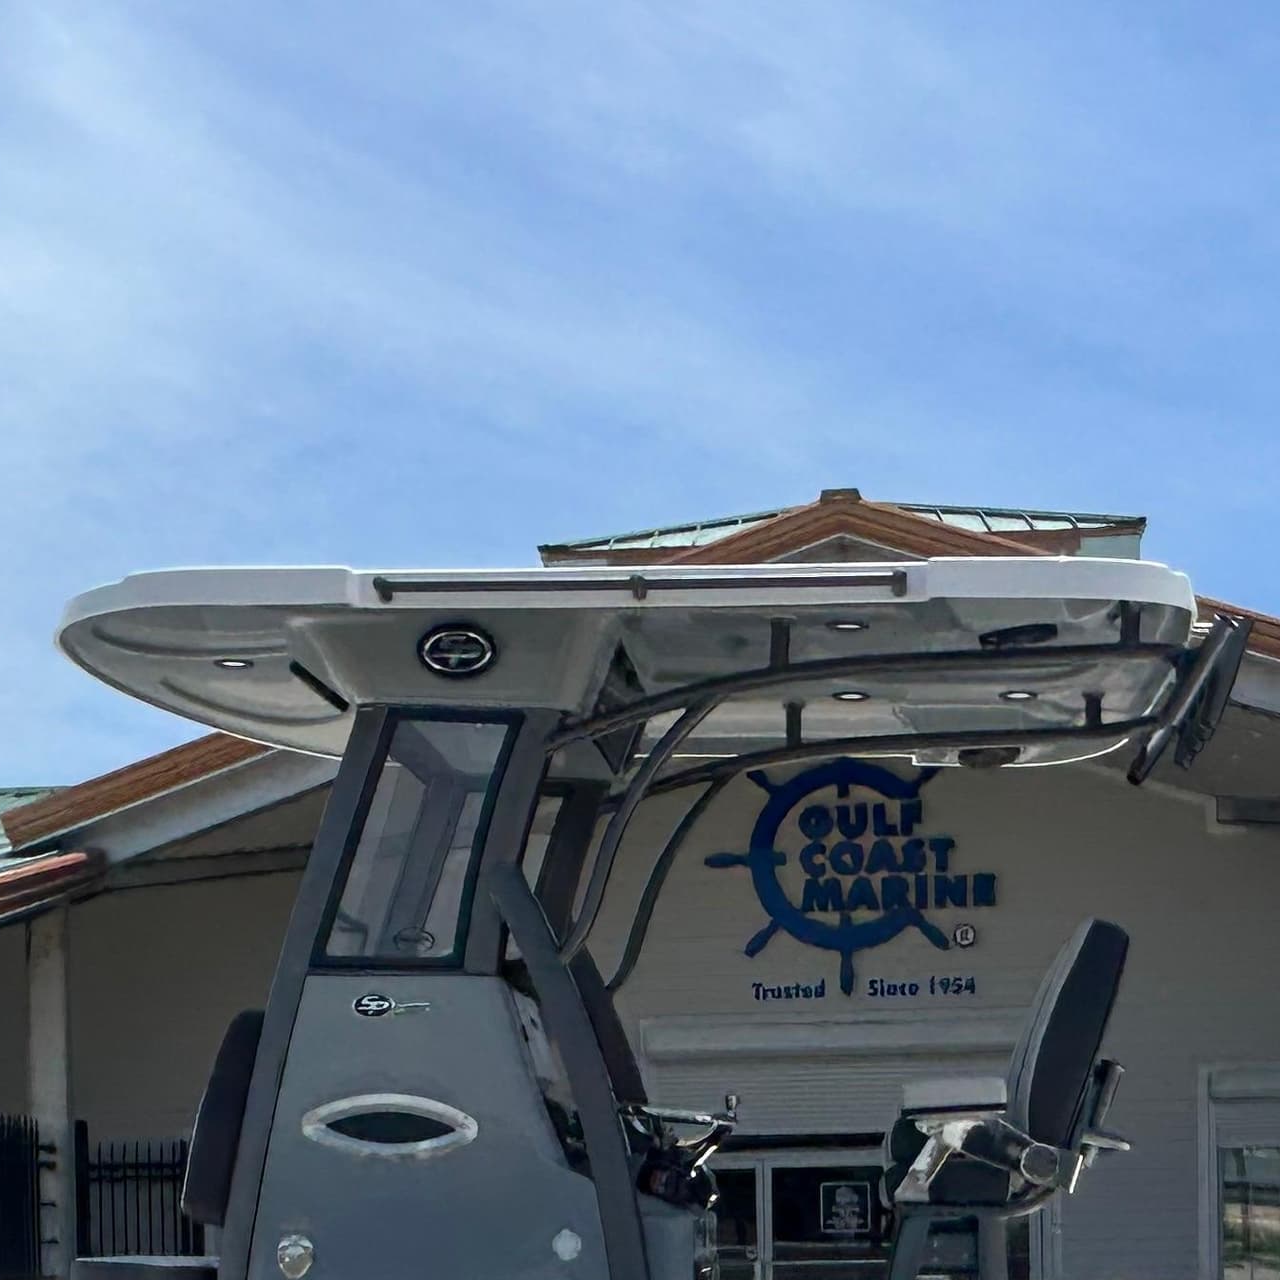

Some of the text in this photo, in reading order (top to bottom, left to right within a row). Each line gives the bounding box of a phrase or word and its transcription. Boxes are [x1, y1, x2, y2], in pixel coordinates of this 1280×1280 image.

[798, 799, 923, 840] GULF
[799, 837, 956, 878] COAST
[801, 872, 997, 913] MARINE
[752, 975, 976, 1000] Trusted Since 1954
